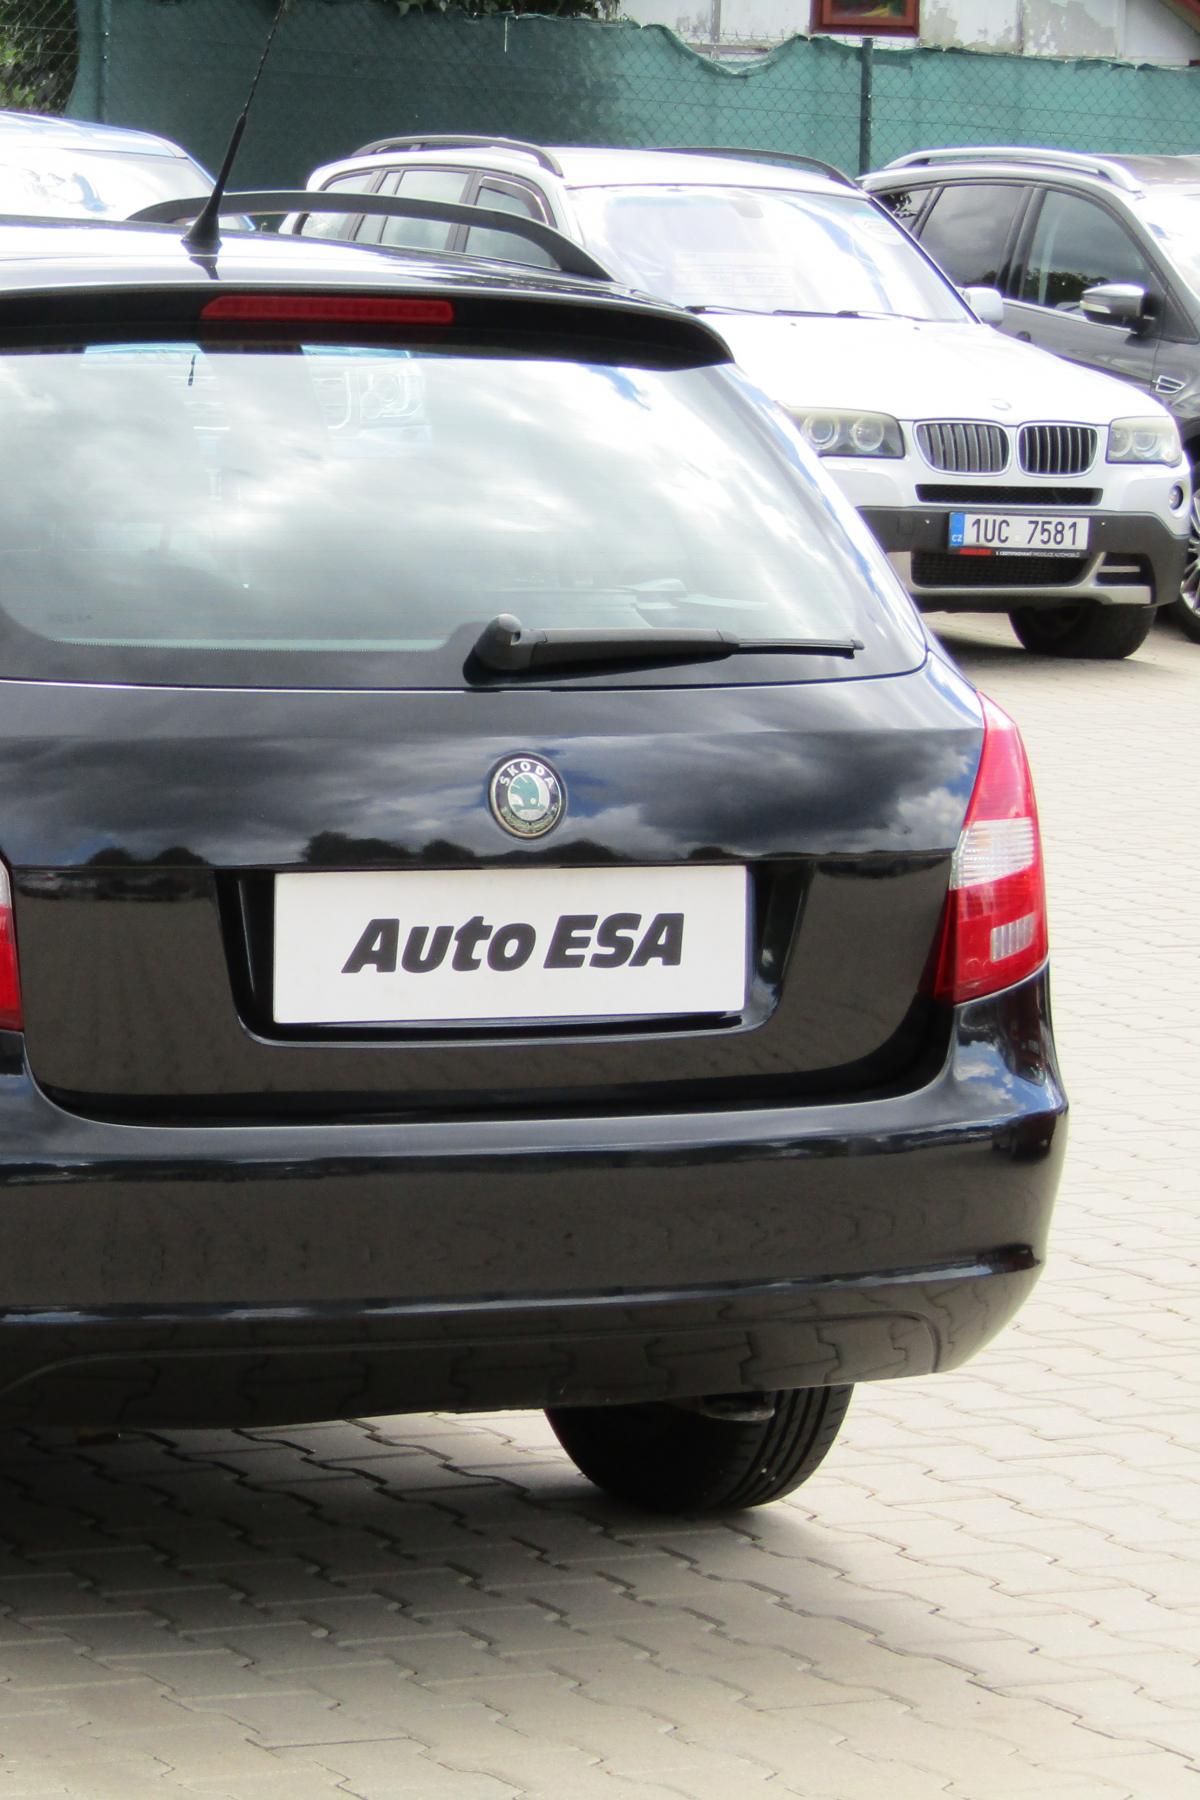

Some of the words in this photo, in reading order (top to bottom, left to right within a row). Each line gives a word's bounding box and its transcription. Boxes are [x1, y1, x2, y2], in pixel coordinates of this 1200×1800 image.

[951, 534, 963, 542] CZ
[971, 518, 1010, 544] 1UC
[1027, 520, 1078, 546] 7581
[341, 914, 537, 974] Auto
[543, 912, 685, 969] ESA
